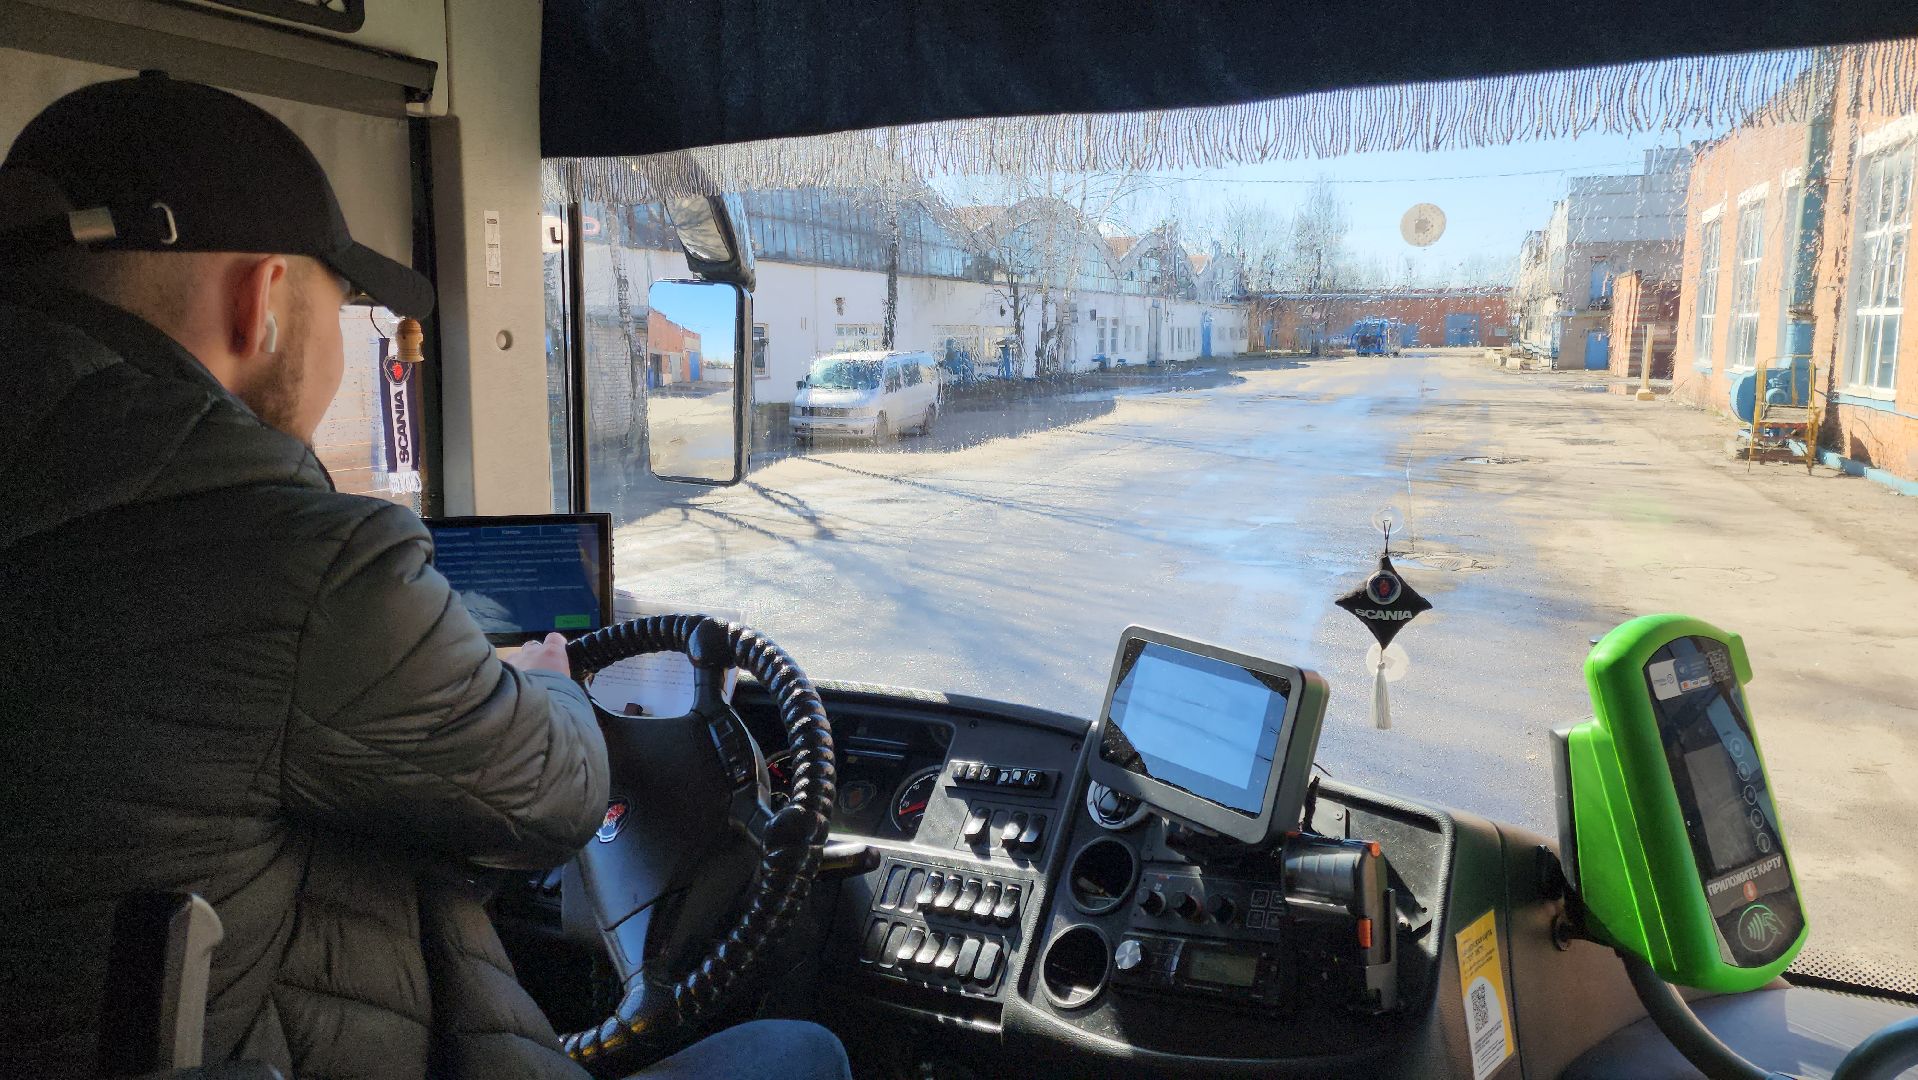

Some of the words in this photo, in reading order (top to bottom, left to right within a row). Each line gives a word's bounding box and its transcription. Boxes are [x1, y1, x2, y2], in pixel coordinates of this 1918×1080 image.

[394, 389, 410, 464] SCANIA
[1355, 608, 1413, 621] SCANIA
[969, 767, 977, 776] 2
[983, 768, 991, 777] 3
[1028, 773, 1037, 782] R
[1707, 866, 1758, 896] ПРИЛОЖИТЕ
[1757, 856, 1781, 876] КАРТУ
